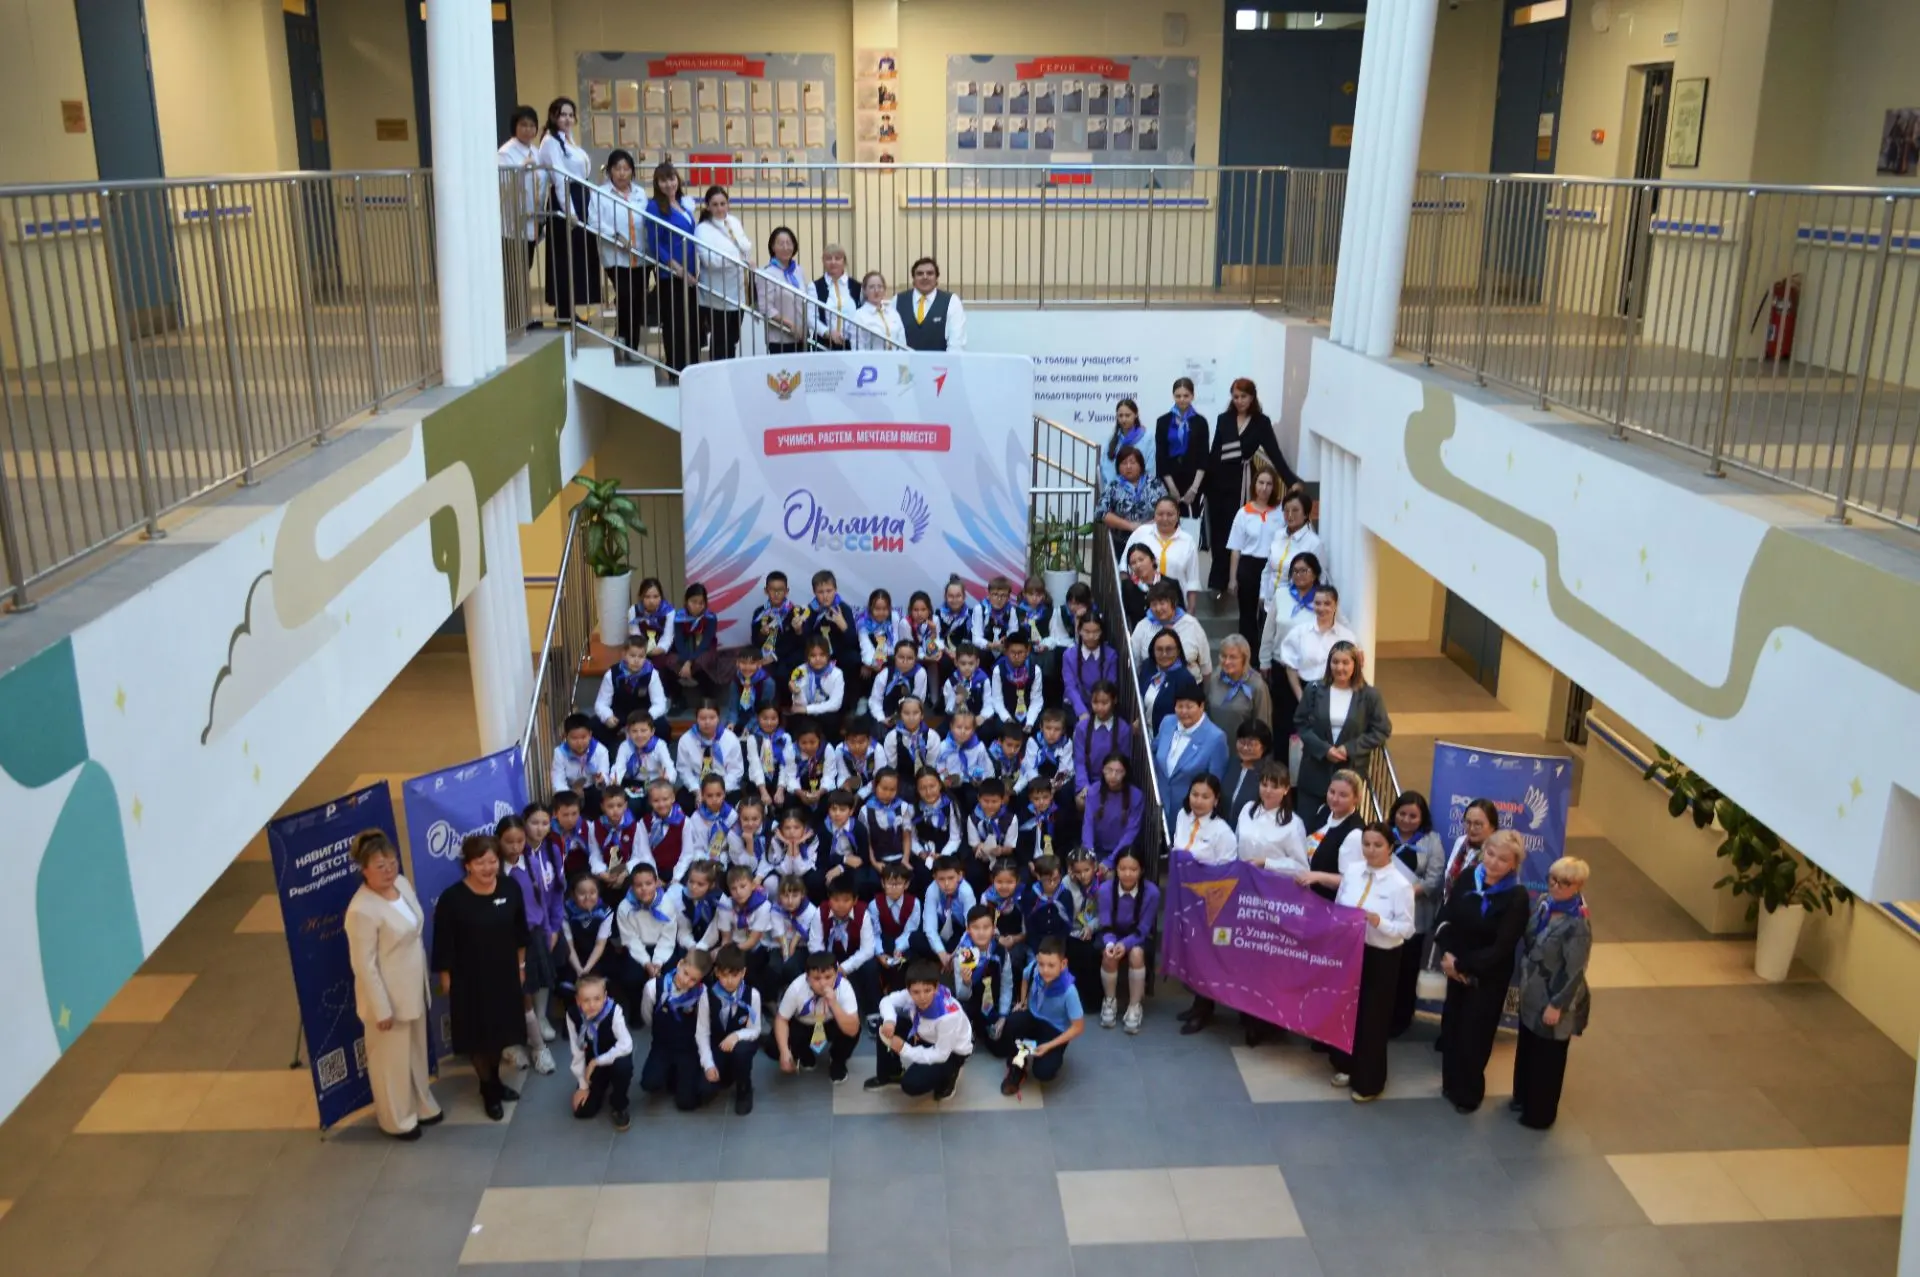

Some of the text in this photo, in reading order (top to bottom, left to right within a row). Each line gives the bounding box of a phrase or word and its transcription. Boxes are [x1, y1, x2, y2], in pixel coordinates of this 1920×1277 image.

[1045, 356, 1078, 364] головы
[1081, 356, 1132, 367] учащегося
[1050, 374, 1099, 382] основание
[1102, 374, 1139, 382] всякого
[1034, 392, 1102, 402] плодотворного
[777, 434, 817, 448] УЧИМСЯ,
[856, 431, 898, 443] МЕЧТАЕМ
[900, 431, 937, 443] ВМЕСТЕ!
[784, 488, 905, 545] Орлята
[814, 535, 904, 553] РОССИИ
[311, 851, 352, 877] ДЕТСТ
[1238, 894, 1305, 916] НАВИГАТОРЫ
[1235, 927, 1243, 936] г.
[1234, 936, 1343, 968] Октябрьский район
